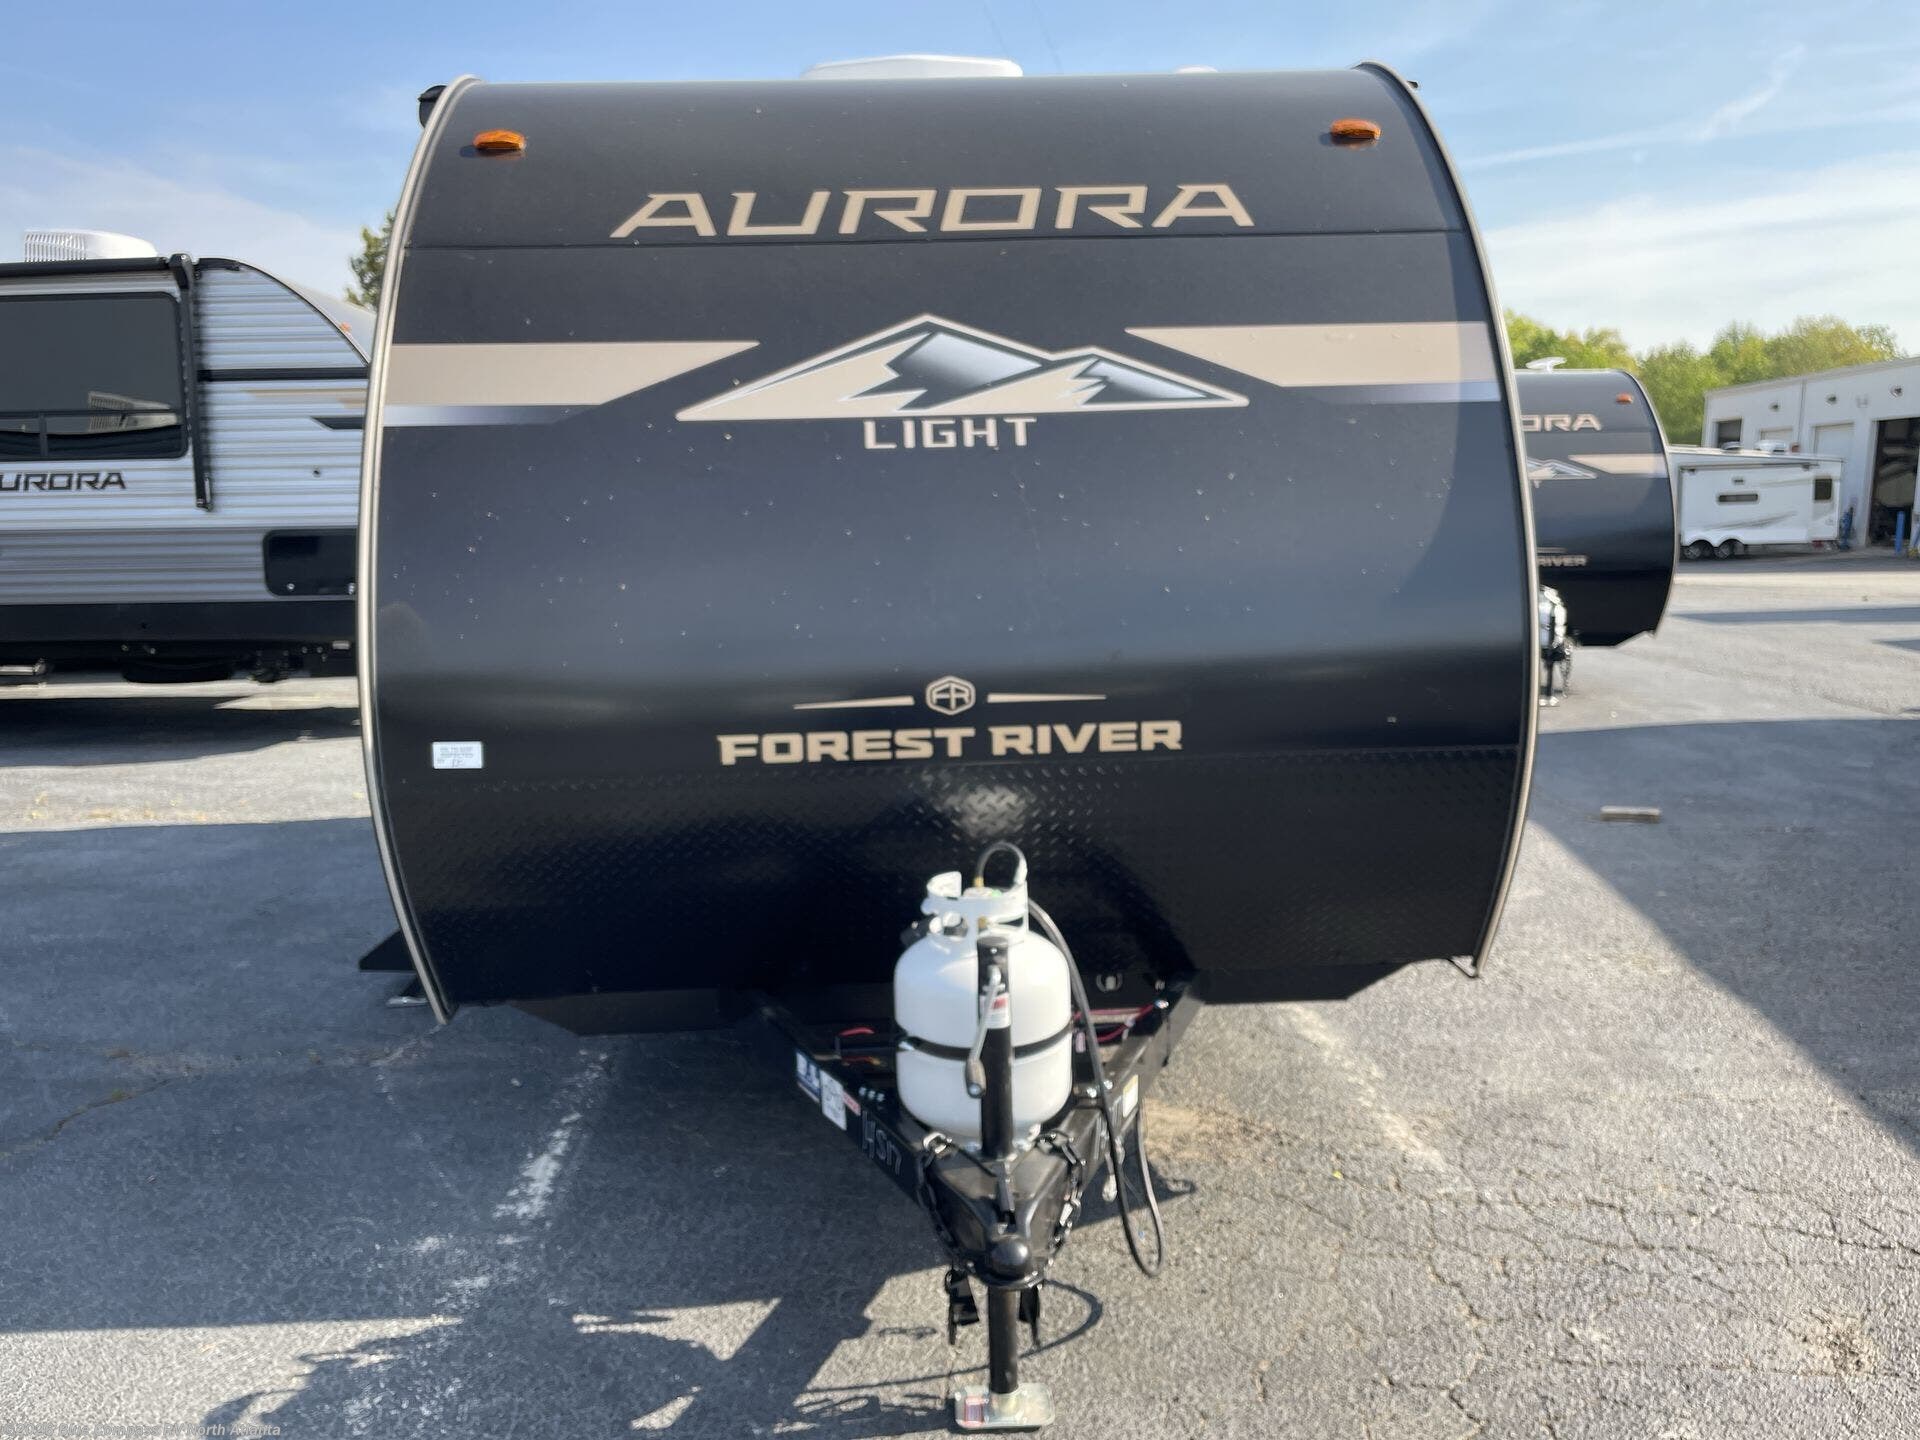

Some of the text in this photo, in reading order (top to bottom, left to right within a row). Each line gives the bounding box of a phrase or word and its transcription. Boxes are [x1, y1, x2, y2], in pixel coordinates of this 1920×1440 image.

[609, 184, 1255, 238] AURORA
[863, 416, 1037, 450] LIGHT
[716, 720, 1184, 766] FOREST RIVER
